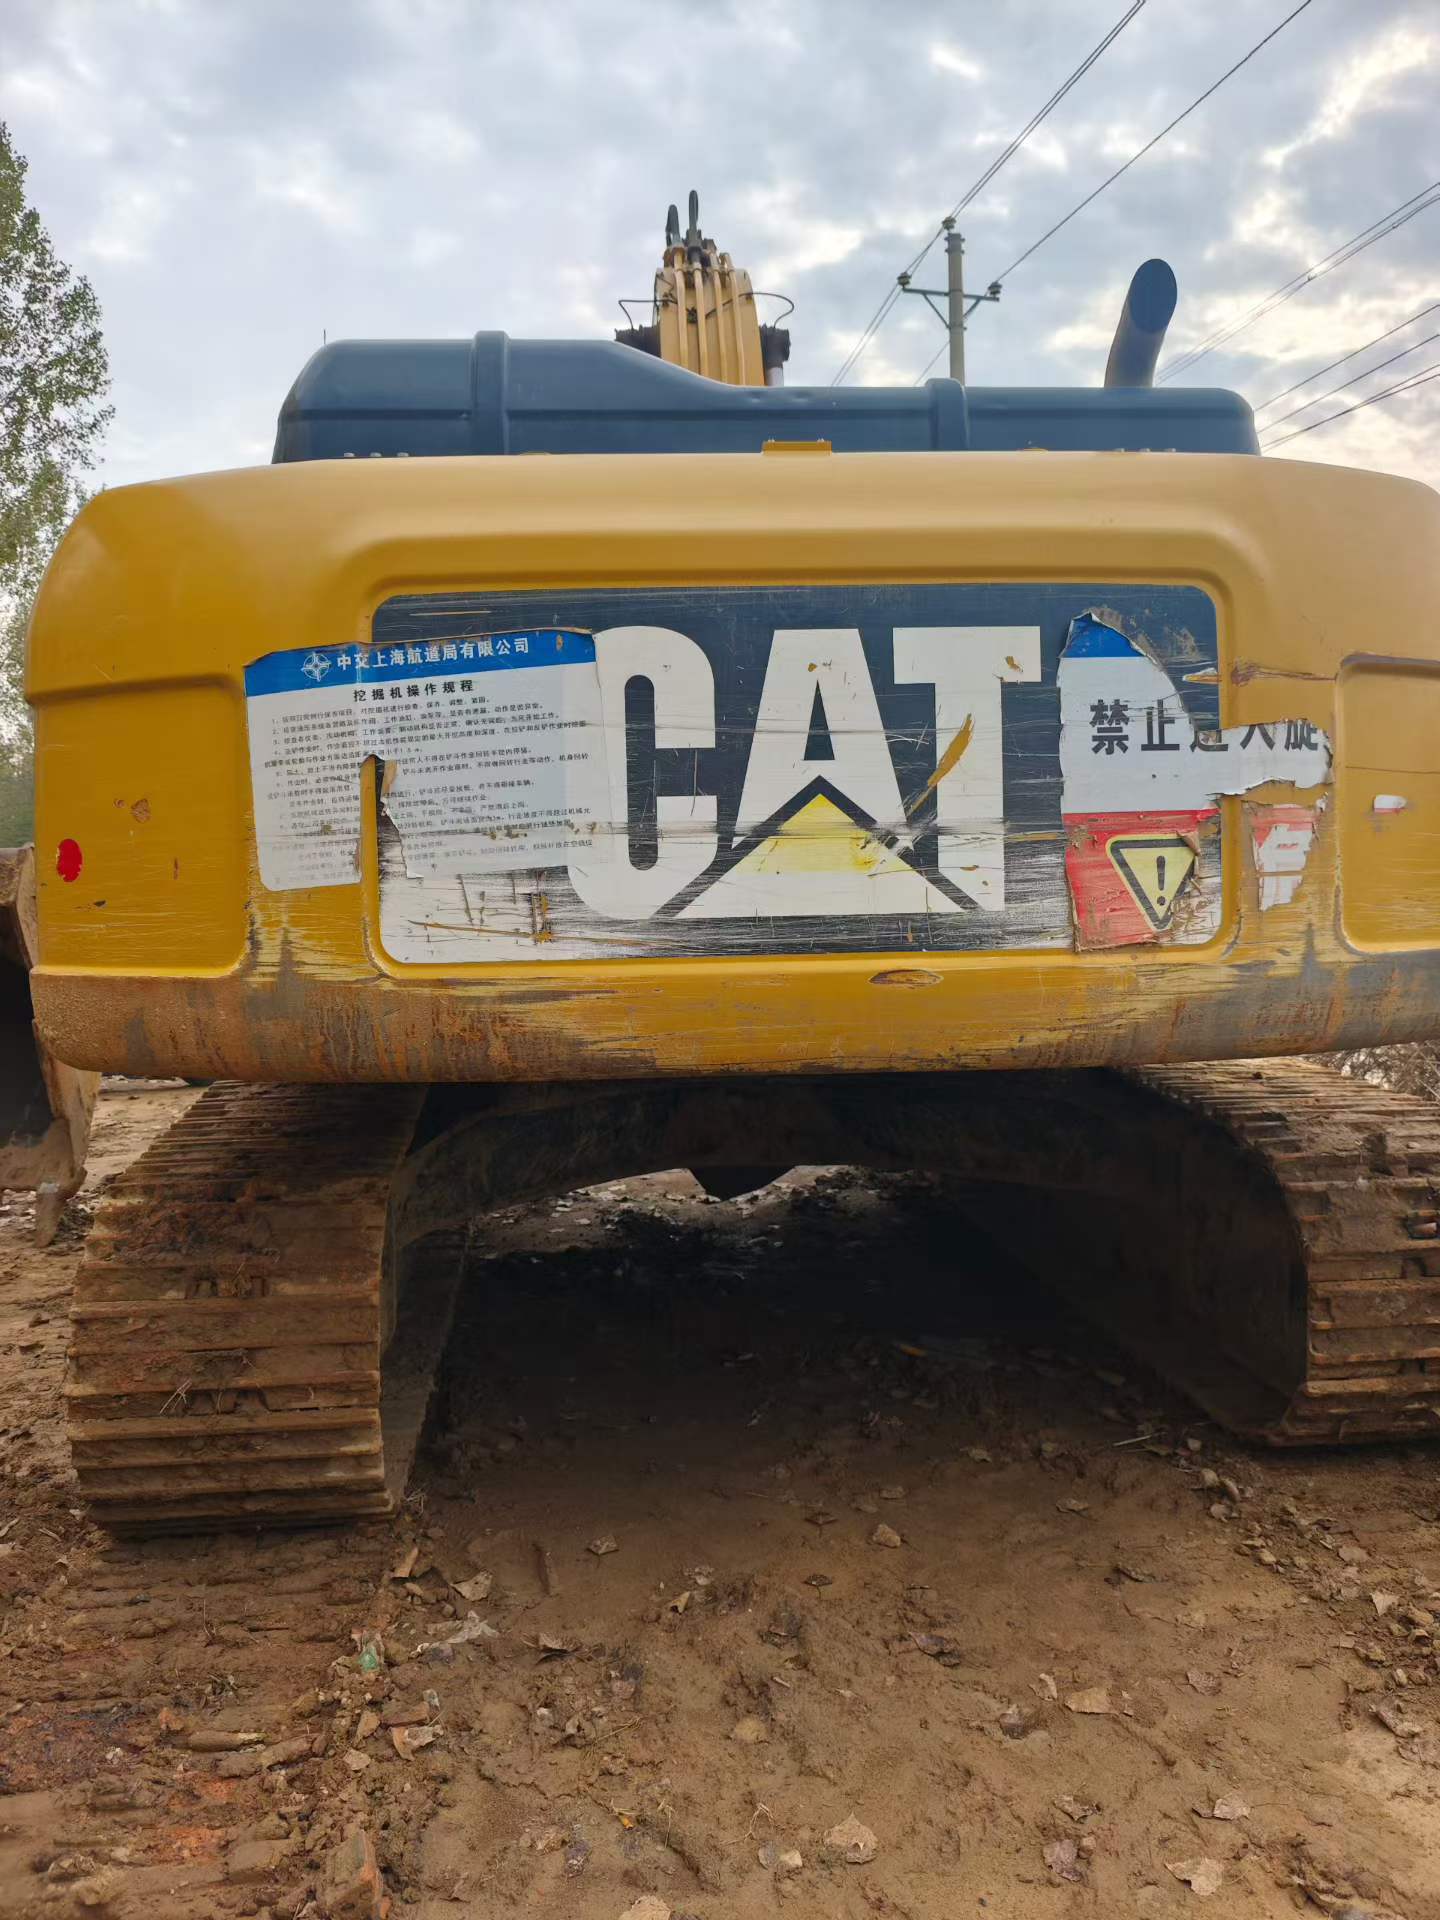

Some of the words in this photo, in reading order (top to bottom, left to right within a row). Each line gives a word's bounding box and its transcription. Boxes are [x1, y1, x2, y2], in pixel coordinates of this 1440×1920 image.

[337, 637, 530, 671] 中交上海航道局有限公司
[353, 679, 475, 703] 挖掘机操作规程
[566, 625, 1042, 921] CAT
